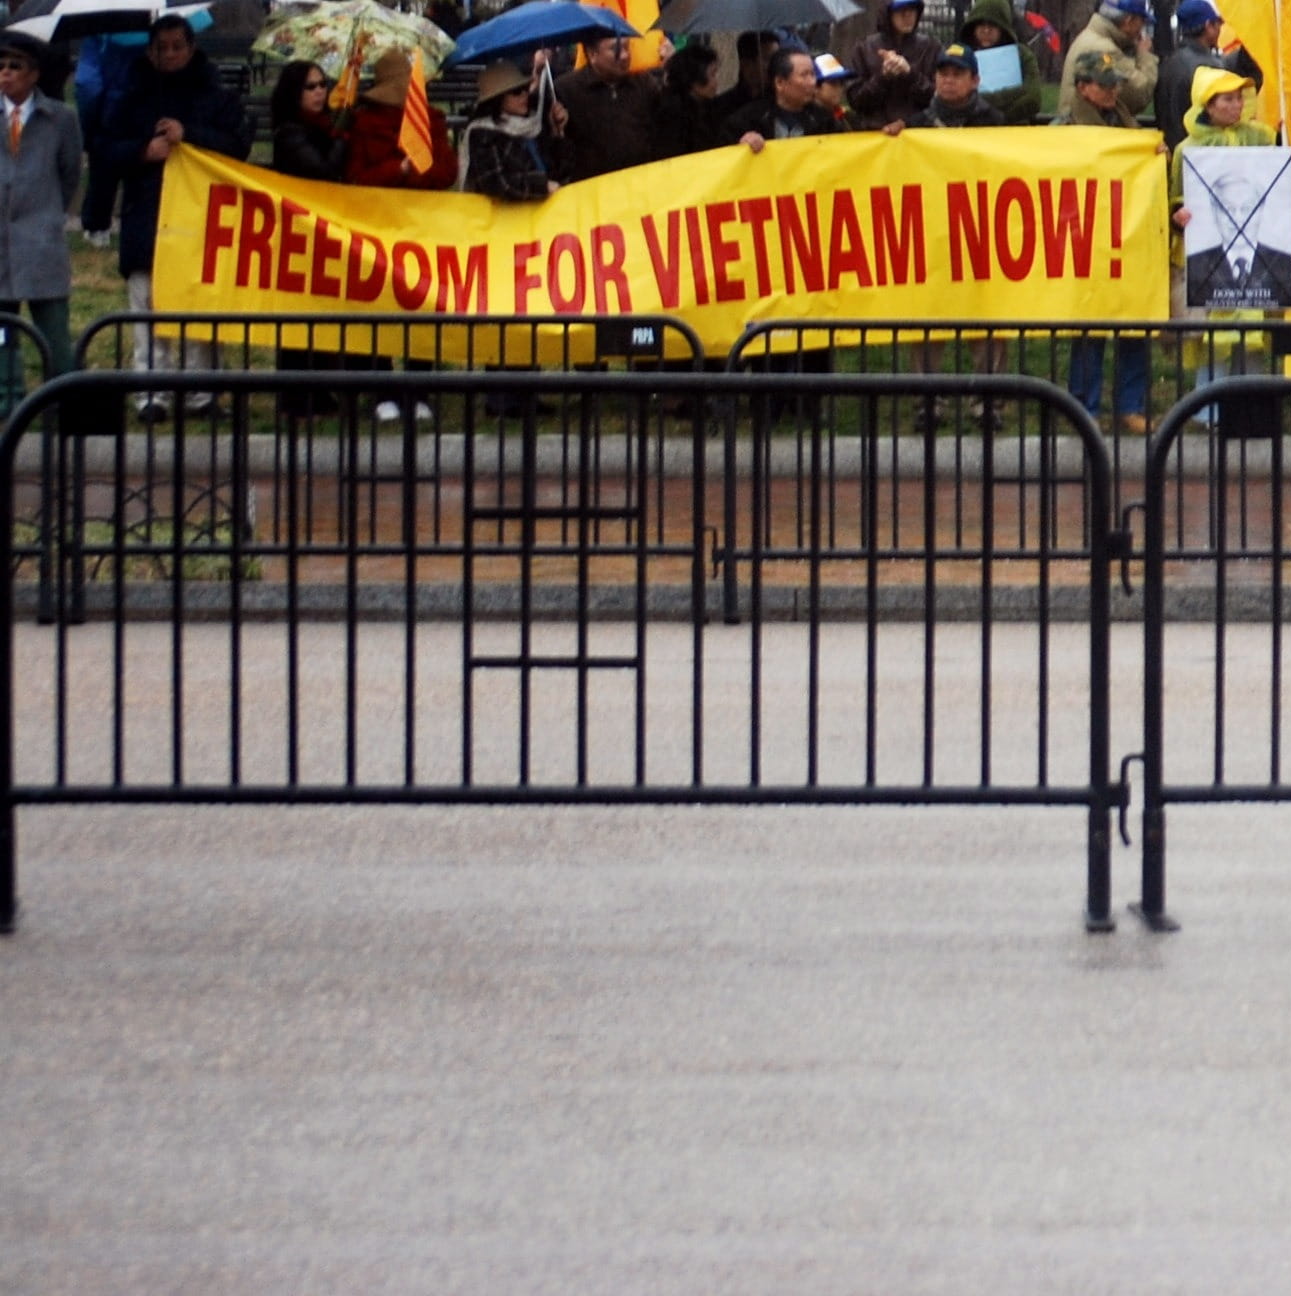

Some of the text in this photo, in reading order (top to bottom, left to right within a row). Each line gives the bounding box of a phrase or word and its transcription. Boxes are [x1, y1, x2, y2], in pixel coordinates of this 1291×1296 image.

[201, 177, 1123, 316] FREEDOM FOR VIETNAM NOW!
[1213, 288, 1271, 298] DOWN WITH
